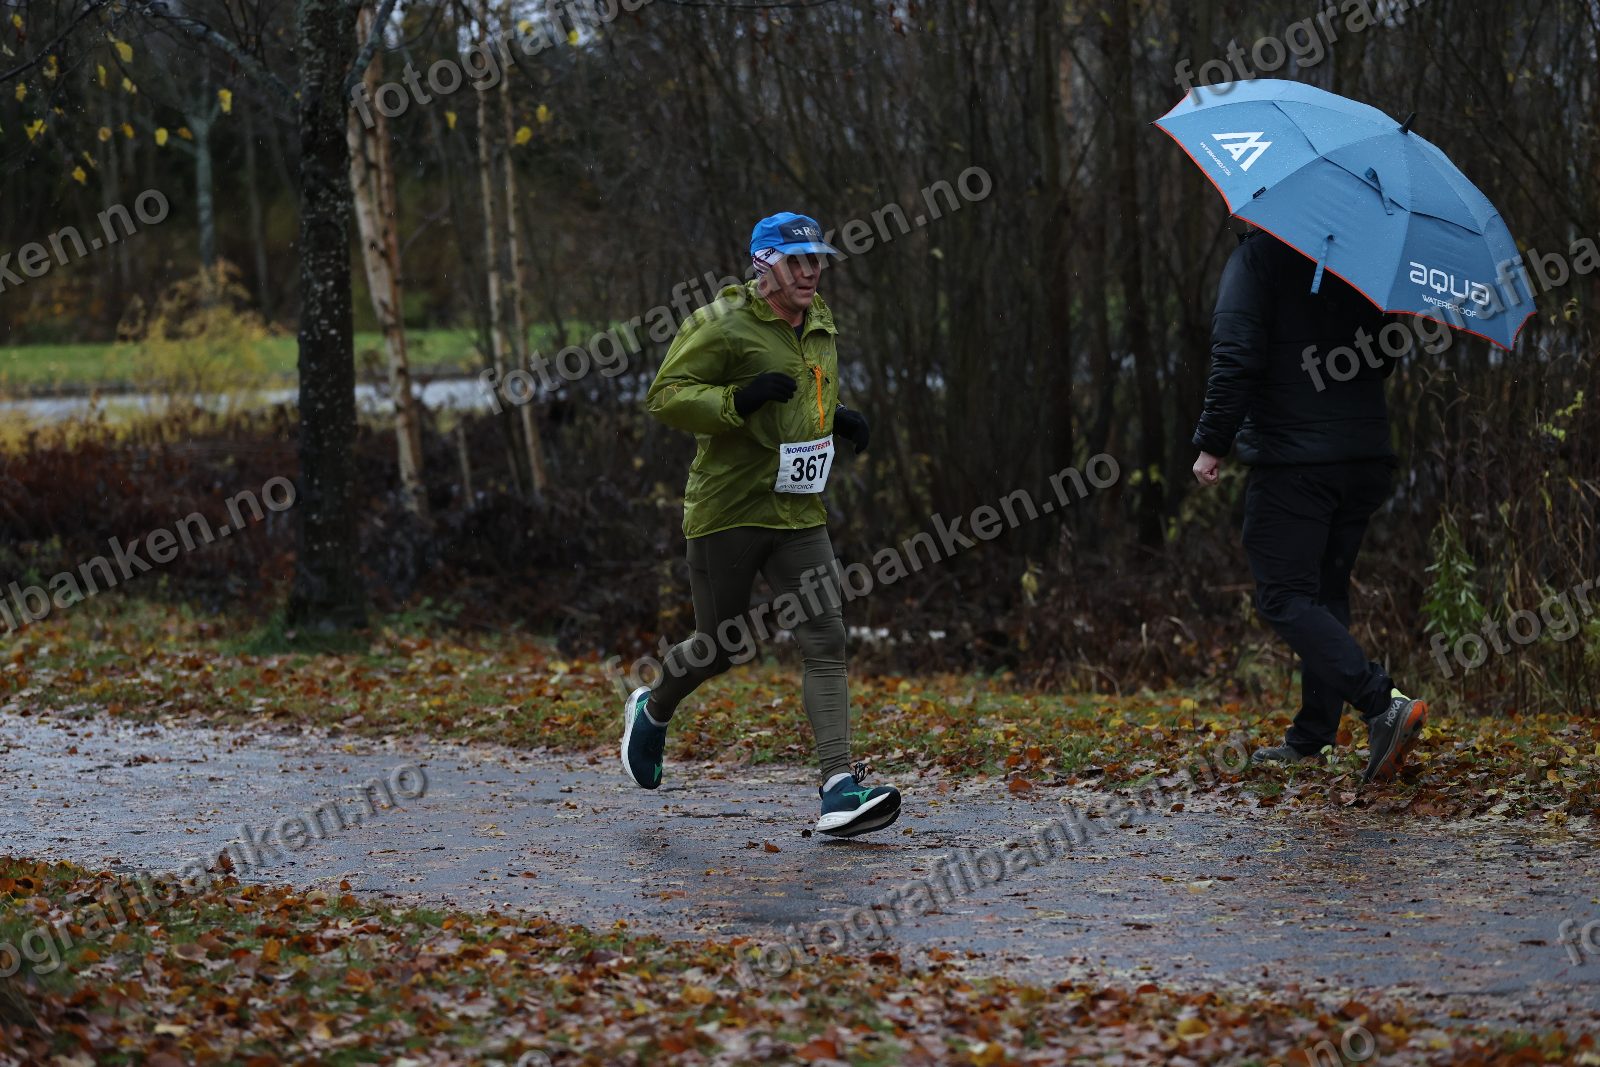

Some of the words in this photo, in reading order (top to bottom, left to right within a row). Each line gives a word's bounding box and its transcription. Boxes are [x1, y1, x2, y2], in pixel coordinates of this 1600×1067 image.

[1421, 294, 1477, 317] WATERPROOF
[791, 452, 828, 482] 367
[1385, 699, 1403, 728] HOKA
